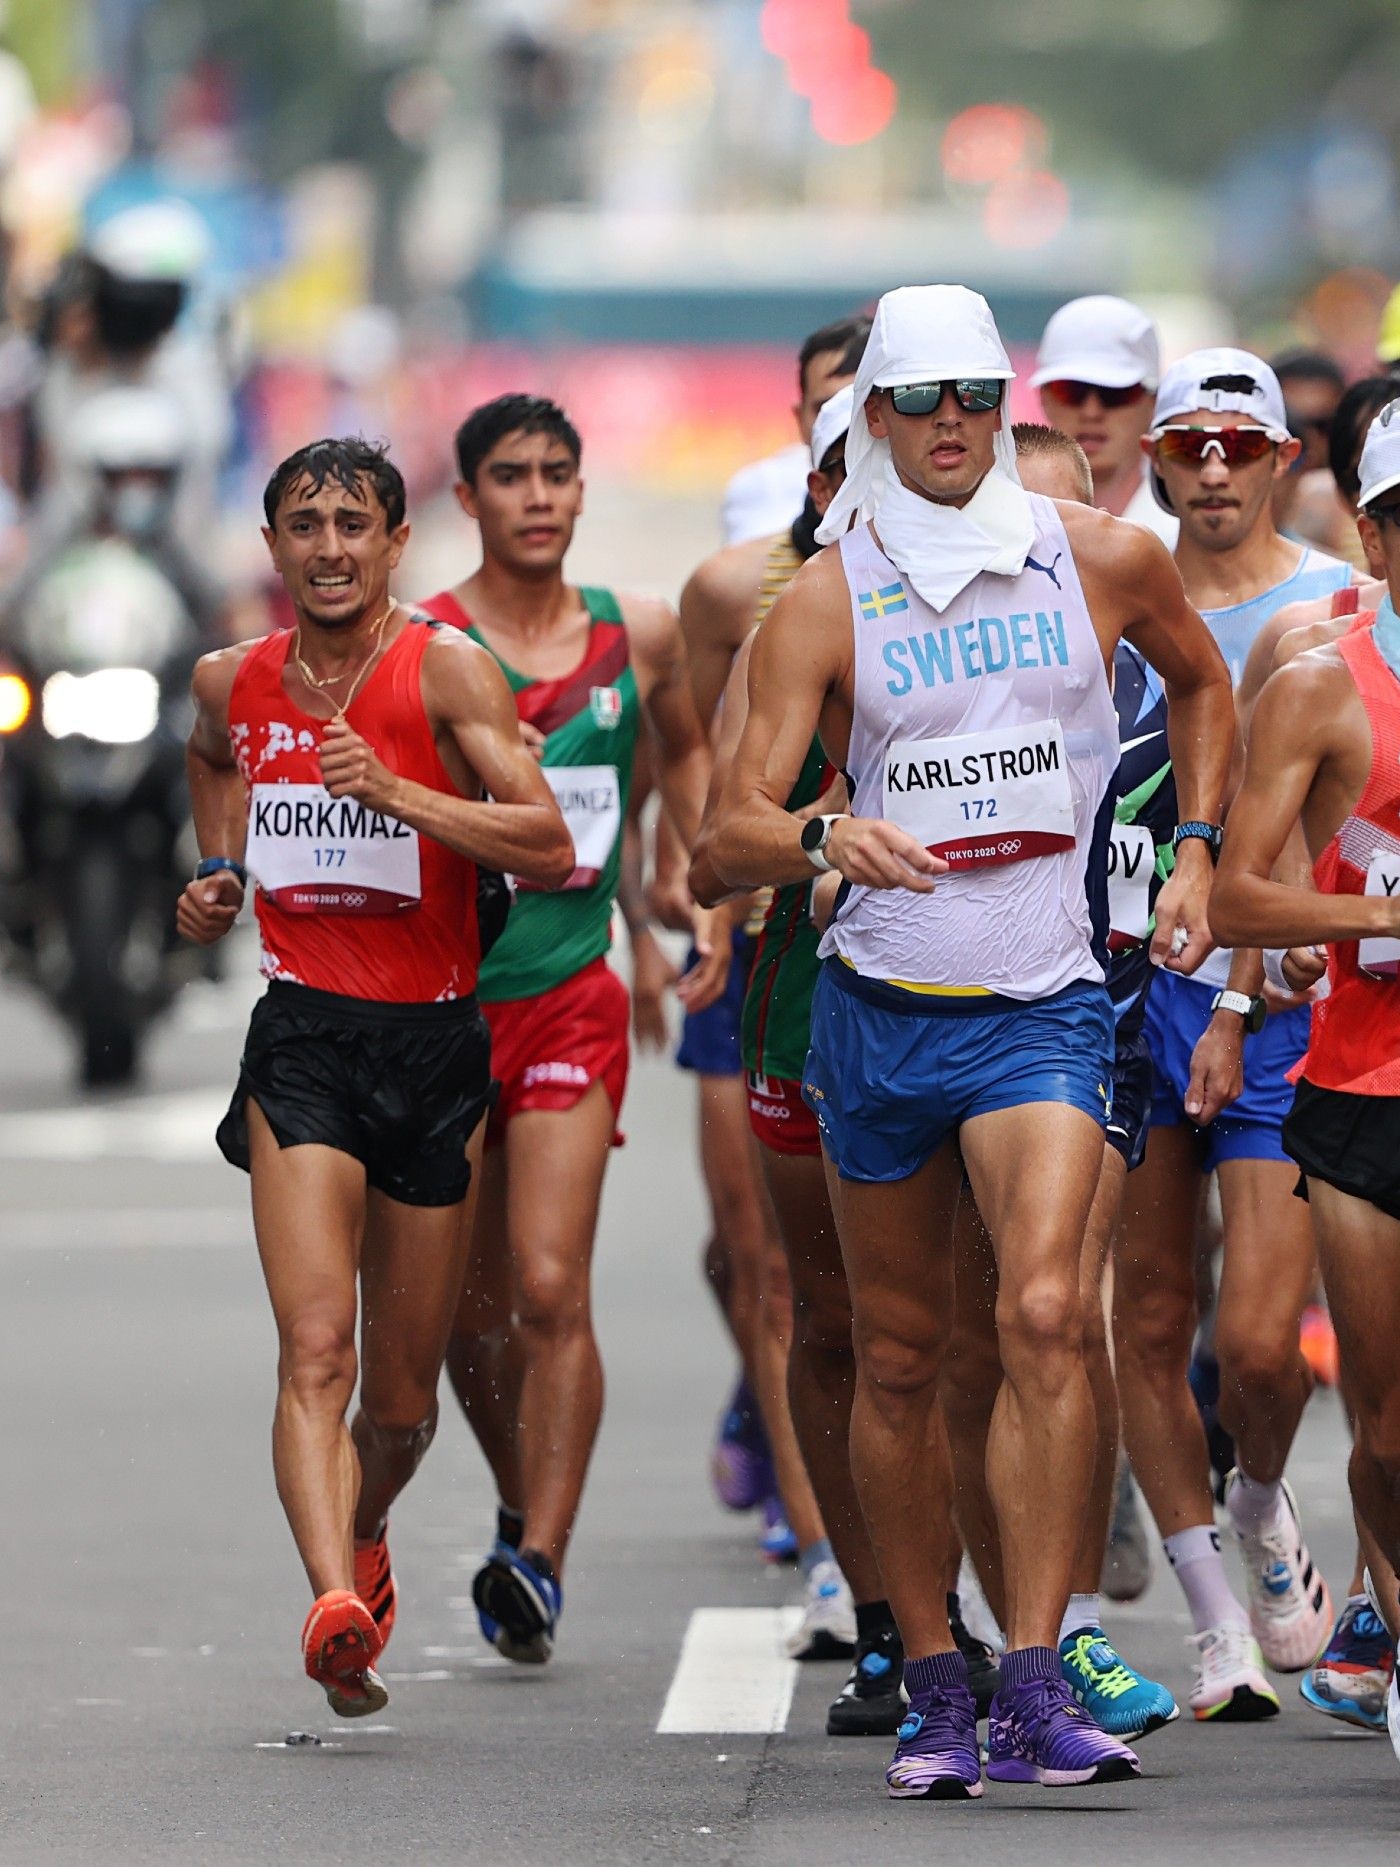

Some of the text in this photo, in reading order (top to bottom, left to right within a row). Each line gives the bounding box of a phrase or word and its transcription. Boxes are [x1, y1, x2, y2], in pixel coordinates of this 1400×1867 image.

[882, 611, 1070, 697] SWEDEN
[888, 741, 1060, 793] KARLSTROM
[960, 798, 998, 821] 172
[313, 848, 347, 867] 177
[944, 846, 996, 861] TOKYO 2020
[293, 892, 340, 904] TOKYO 2020
